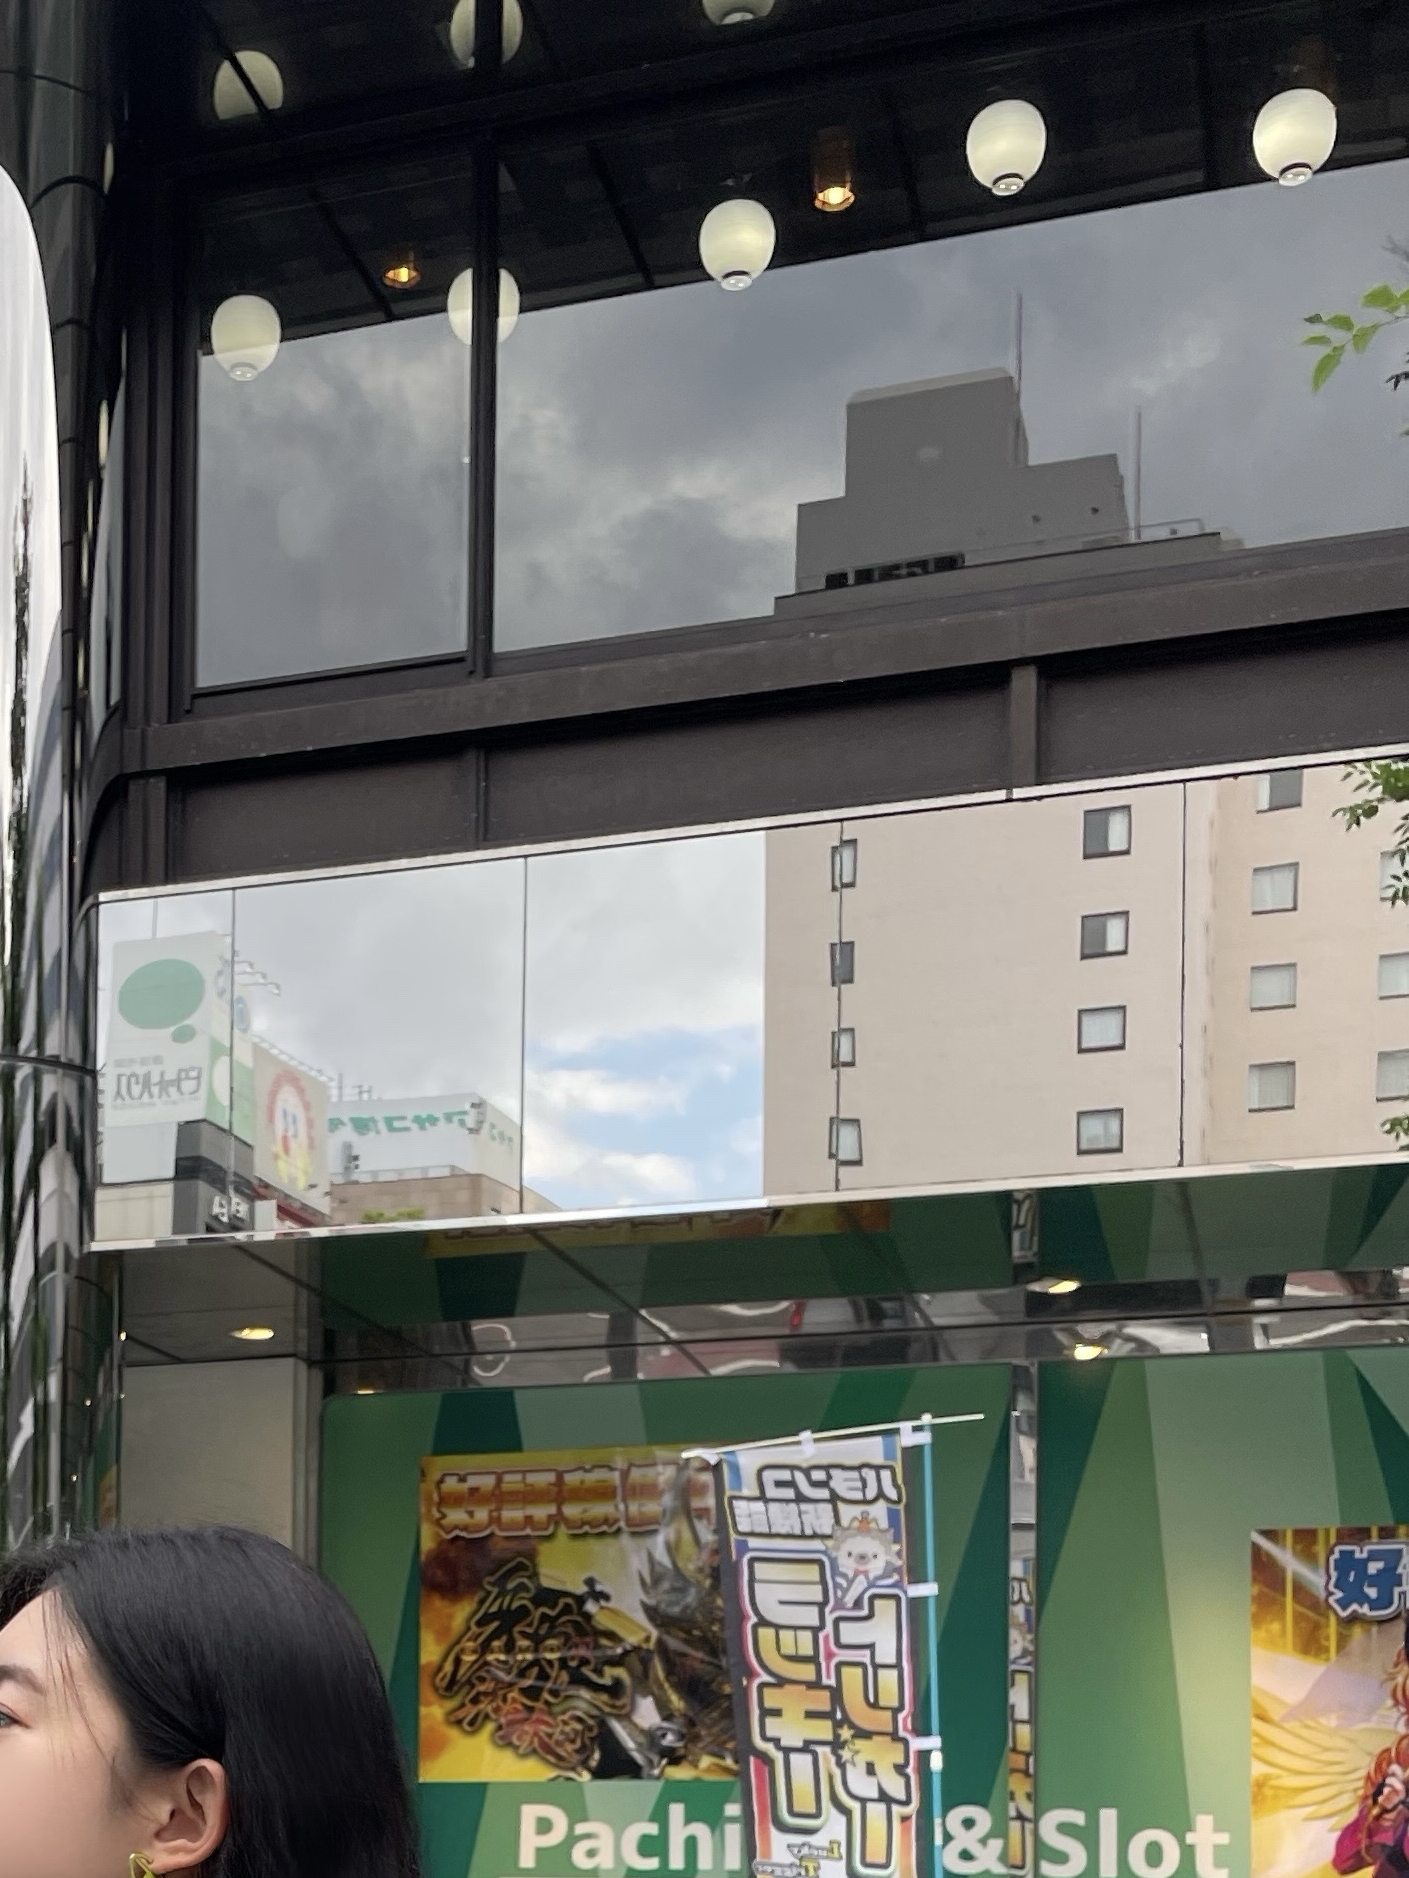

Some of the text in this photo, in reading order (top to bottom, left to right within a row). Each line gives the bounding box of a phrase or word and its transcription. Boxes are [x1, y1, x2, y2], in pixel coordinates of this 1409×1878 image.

[1334, 1547, 1409, 1613] 好
[516, 1802, 742, 1871] Pachi
[943, 1803, 1010, 1877] &
